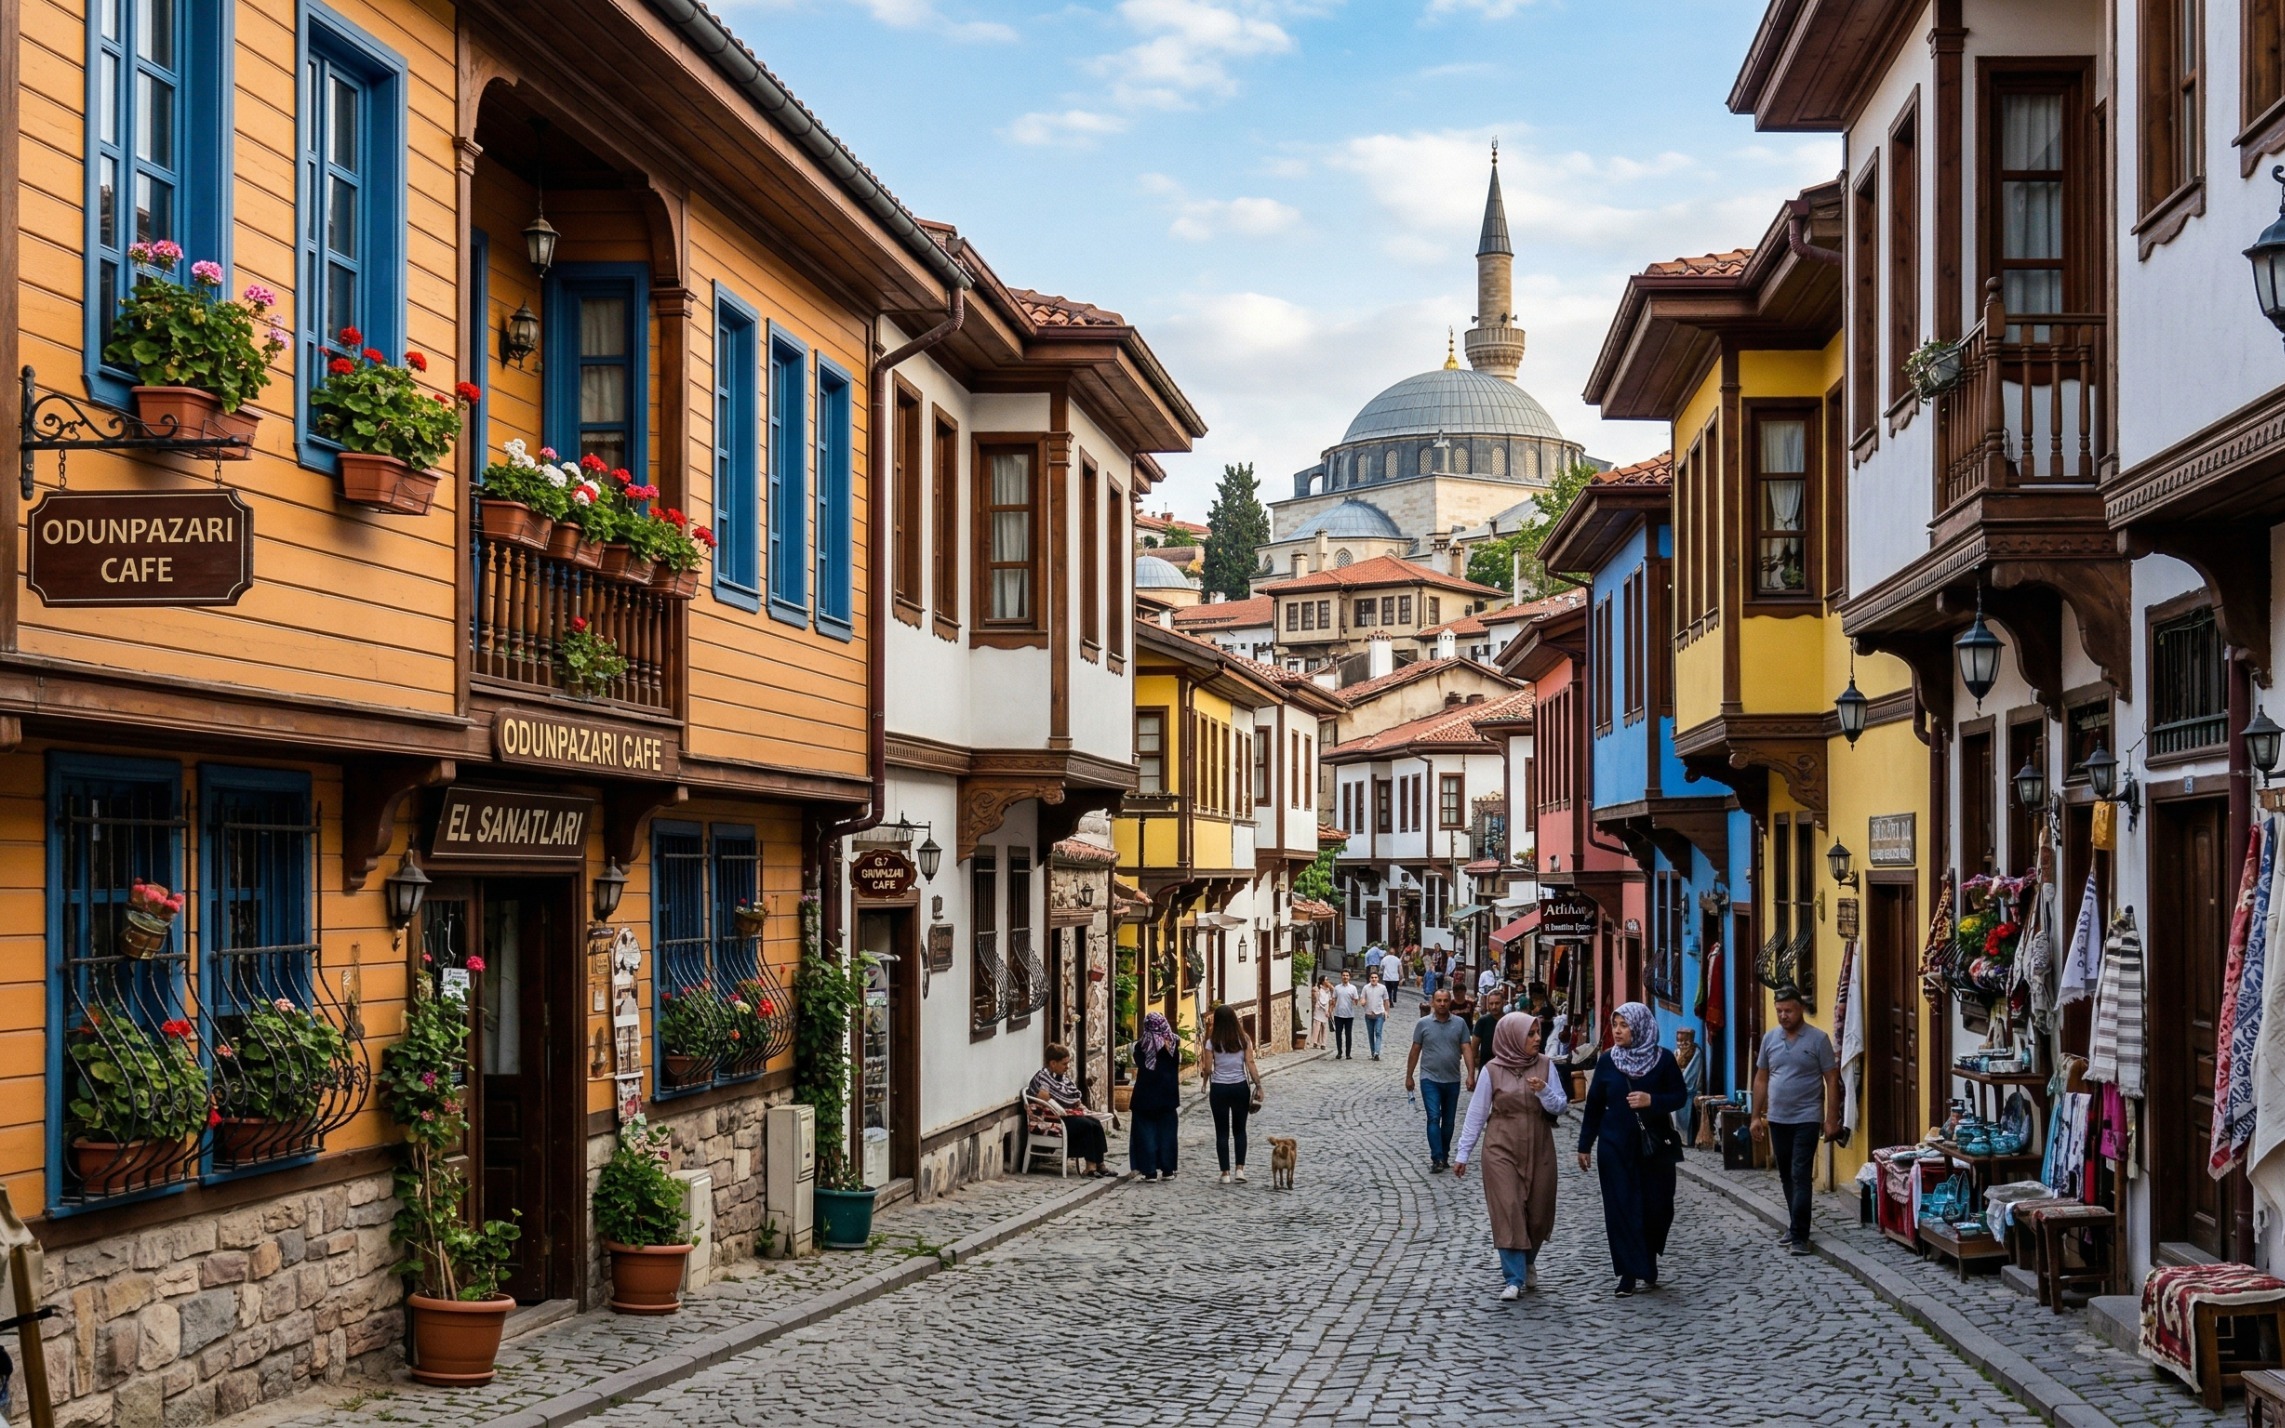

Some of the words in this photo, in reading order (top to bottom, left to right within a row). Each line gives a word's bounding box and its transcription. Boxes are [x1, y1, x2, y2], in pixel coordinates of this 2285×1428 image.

[42, 517, 233, 545] ODUNPAZARI
[101, 557, 173, 583] CAFE
[503, 718, 617, 766] ODUNPAZARI
[622, 735, 662, 771] CAFE
[446, 803, 471, 842] EL
[477, 805, 583, 845] SANATLARI
[872, 880, 896, 889] CAFE
